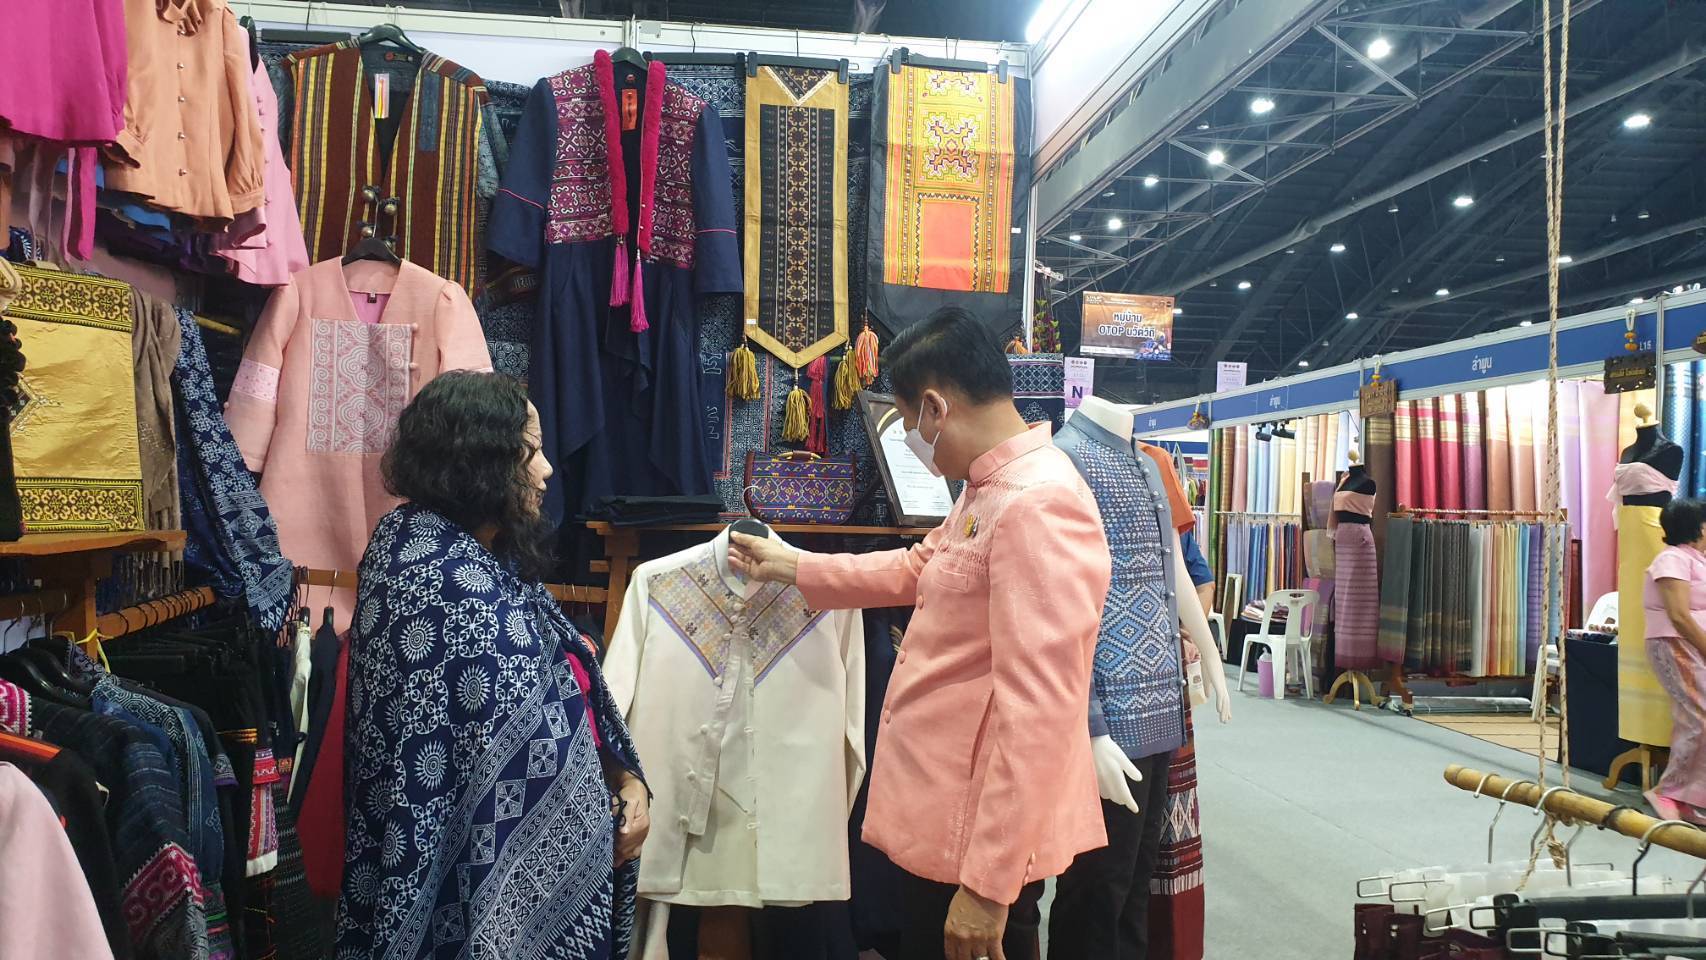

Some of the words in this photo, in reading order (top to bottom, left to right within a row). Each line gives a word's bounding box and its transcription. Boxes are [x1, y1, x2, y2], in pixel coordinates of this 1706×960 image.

[1113, 311, 1142, 325] หมู่บ้าน
[1099, 325, 1124, 335] OTOP
[1071, 385, 1083, 399] N
